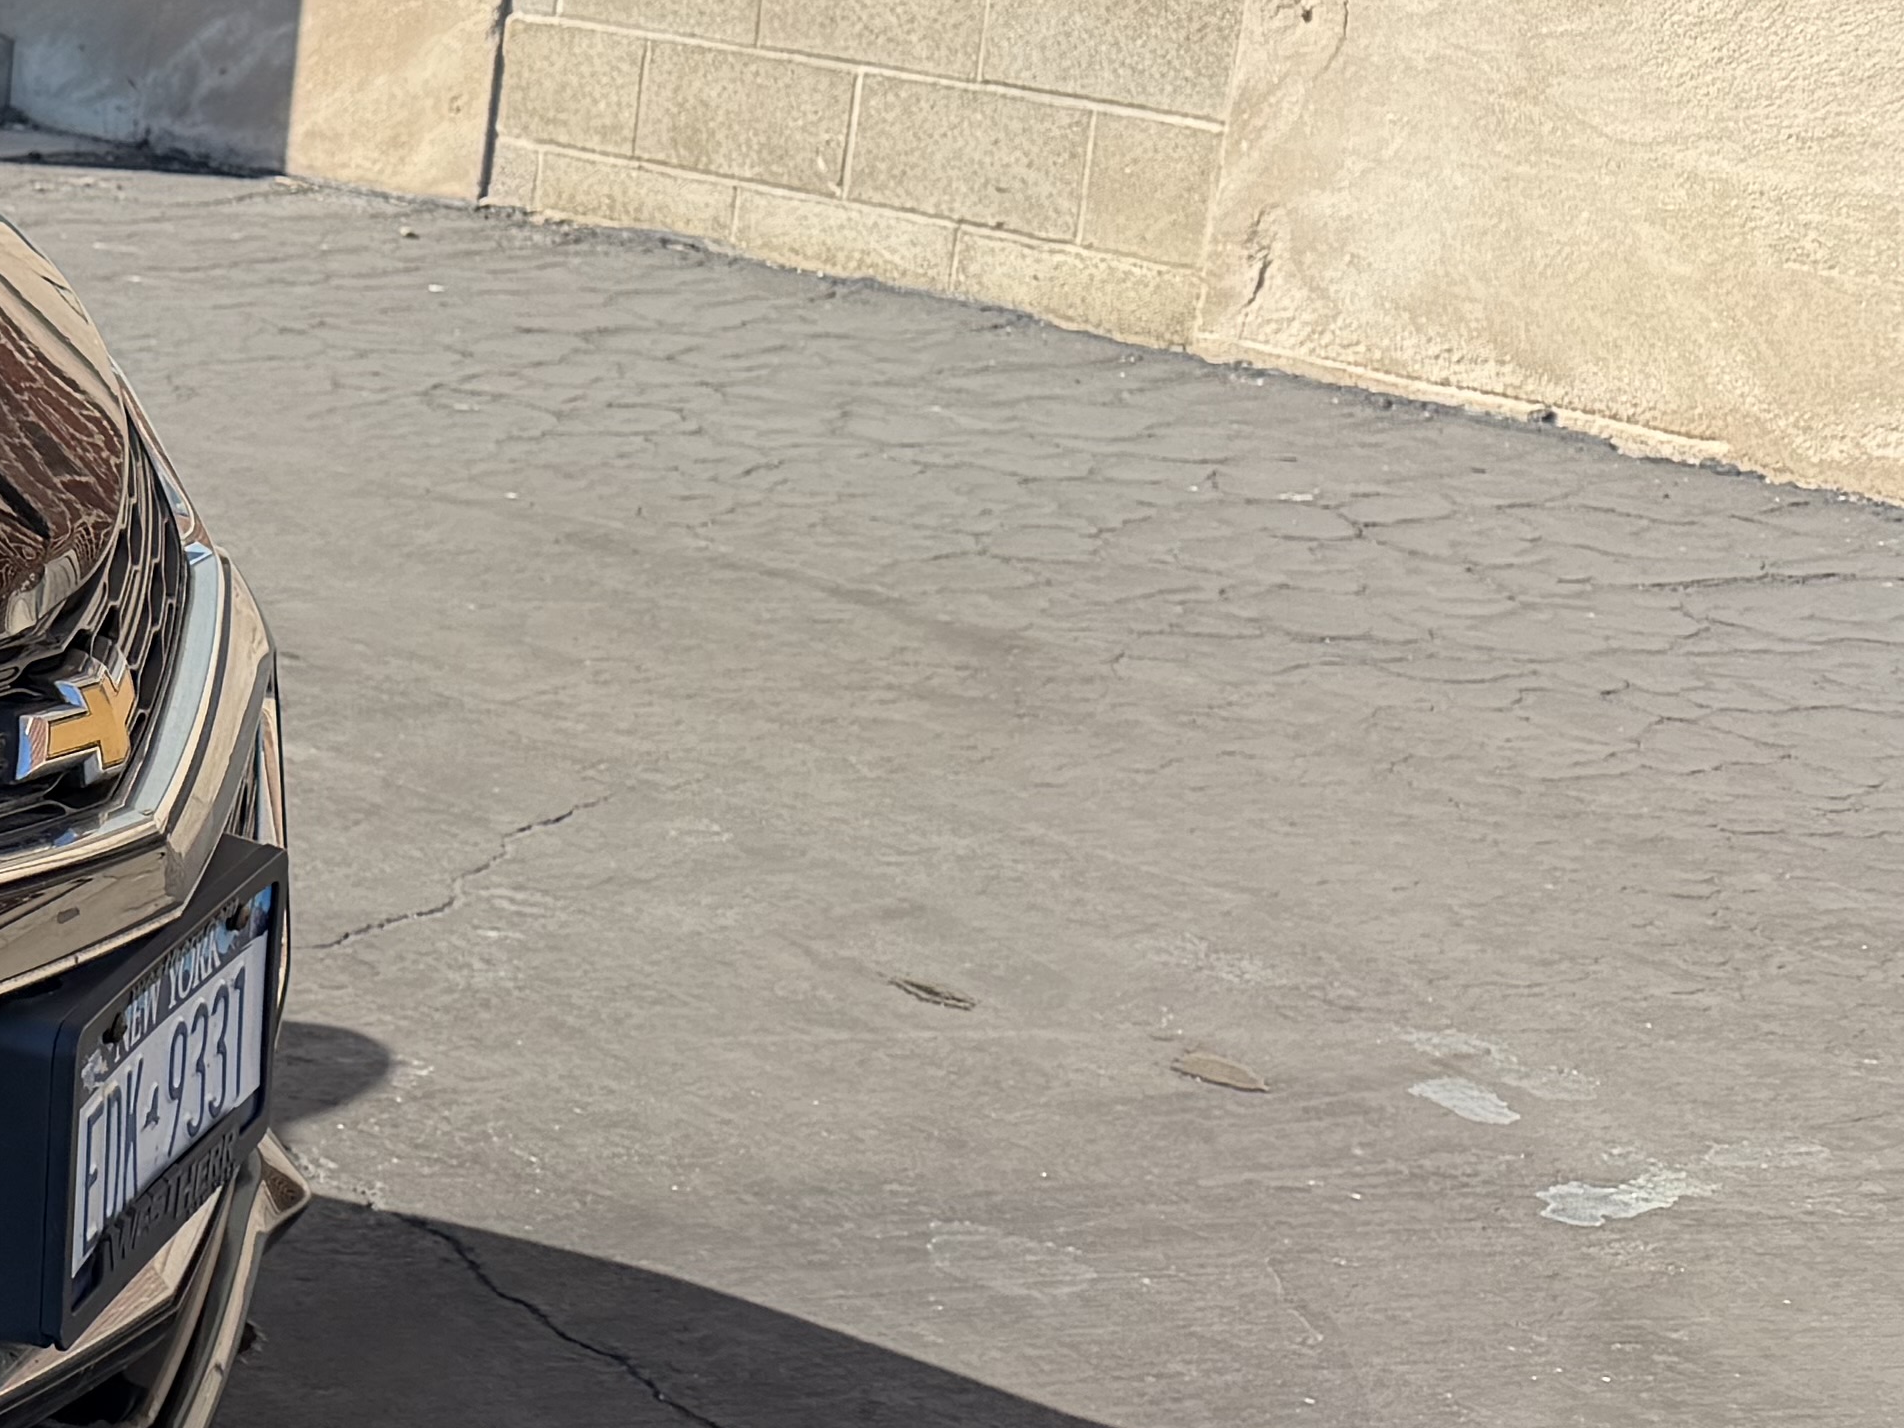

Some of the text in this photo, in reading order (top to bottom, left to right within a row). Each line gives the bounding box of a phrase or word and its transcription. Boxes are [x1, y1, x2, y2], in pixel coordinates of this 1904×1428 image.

[114, 976, 162, 1063] NEW
[165, 928, 221, 1010] YORK
[167, 965, 247, 1158] 9331
